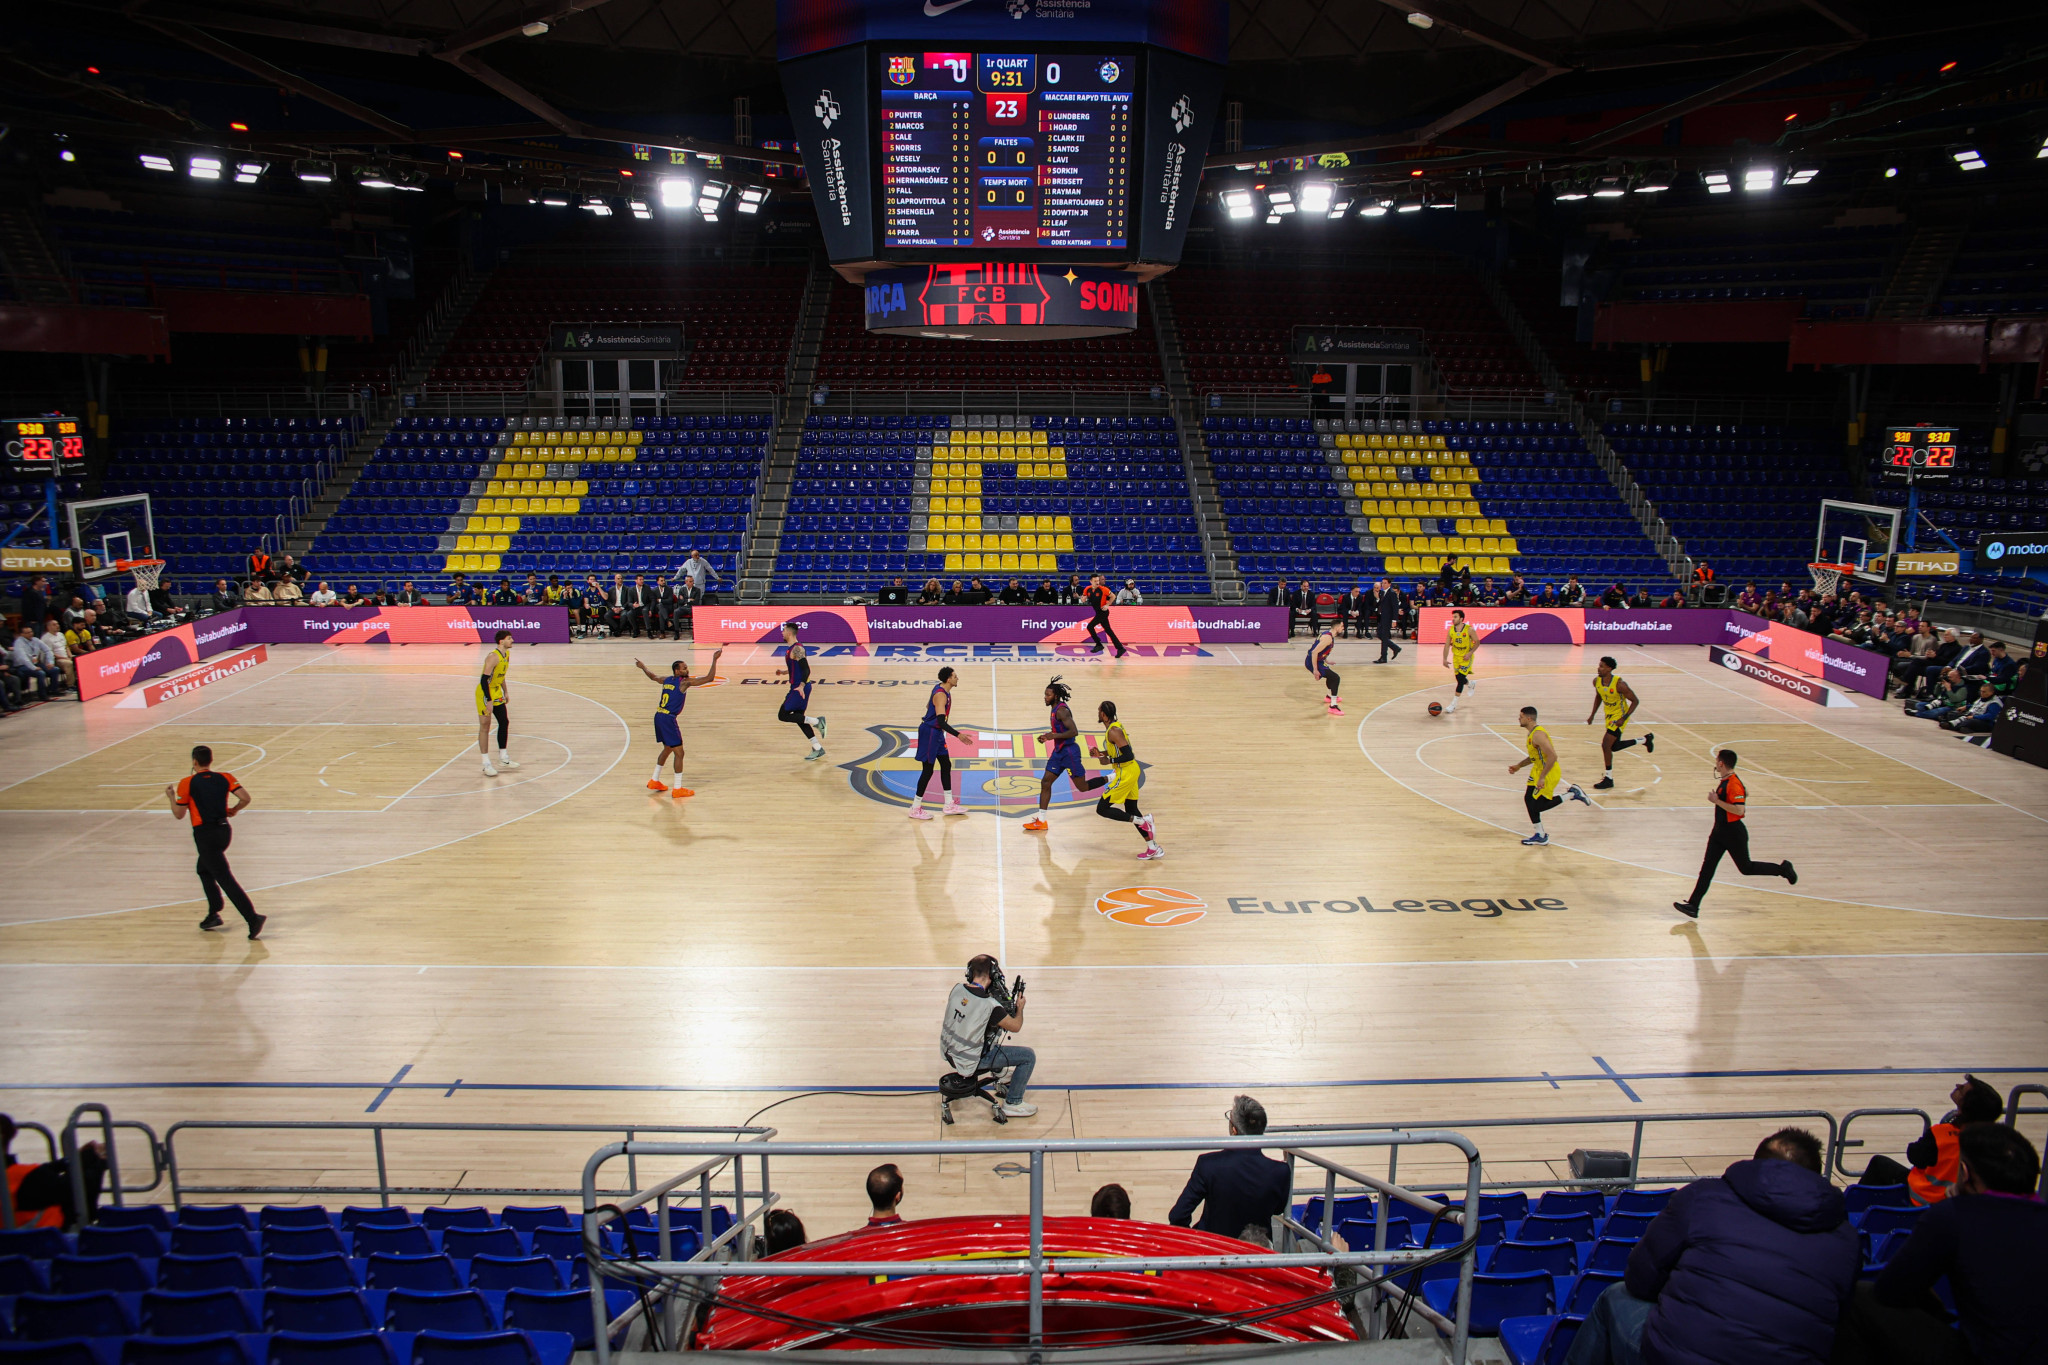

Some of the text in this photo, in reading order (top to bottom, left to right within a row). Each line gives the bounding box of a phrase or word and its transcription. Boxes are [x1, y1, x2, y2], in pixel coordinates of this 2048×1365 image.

[998, 59, 1028, 67] QUART
[992, 72, 1022, 86] 9:31
[1047, 64, 1060, 83] 0
[996, 101, 1017, 117] 23
[670, 153, 685, 164] 12
[988, 152, 1025, 163] 0 0
[822, 140, 837, 201] Sanitària
[1160, 142, 1177, 202] Sanitària
[831, 138, 851, 226] Assistència
[1165, 143, 1186, 230] Assistència
[988, 191, 1024, 202] 0 0
[564, 332, 576, 347] A
[1305, 336, 1317, 351] A
[24, 439, 53, 459] 22
[62, 438, 83, 458] 22
[1893, 447, 1913, 466] 22
[1926, 448, 1954, 466] 22
[2, 557, 72, 568] ETIHAD
[1896, 561, 1958, 572] ETIHAD
[304, 620, 390, 632] Find your pace
[448, 620, 540, 629] visitabudhabi.ae
[721, 619, 808, 631] Find your pce
[868, 619, 962, 629] visitabudhabi.ae
[1022, 619, 1047, 629] Find
[1050, 622, 1077, 631] your
[1168, 620, 1261, 629] visitabudhabi.ae
[1473, 622, 1498, 631] your
[1501, 622, 1528, 632] pace
[1584, 621, 1672, 631] visitabudhabi.ae
[195, 622, 247, 645] visitabudhabi.ae
[1726, 622, 1773, 645] Find your pace
[100, 651, 161, 678] Find your pace
[1805, 649, 1866, 677] visitabudhabi.ae
[160, 665, 214, 688] experience
[160, 655, 257, 701] abu dhabi
[1745, 663, 1811, 695] motorola
[661, 693, 670, 707] 0
[1227, 896, 1568, 918] EuroLeague
[953, 1009, 965, 1023] TV
